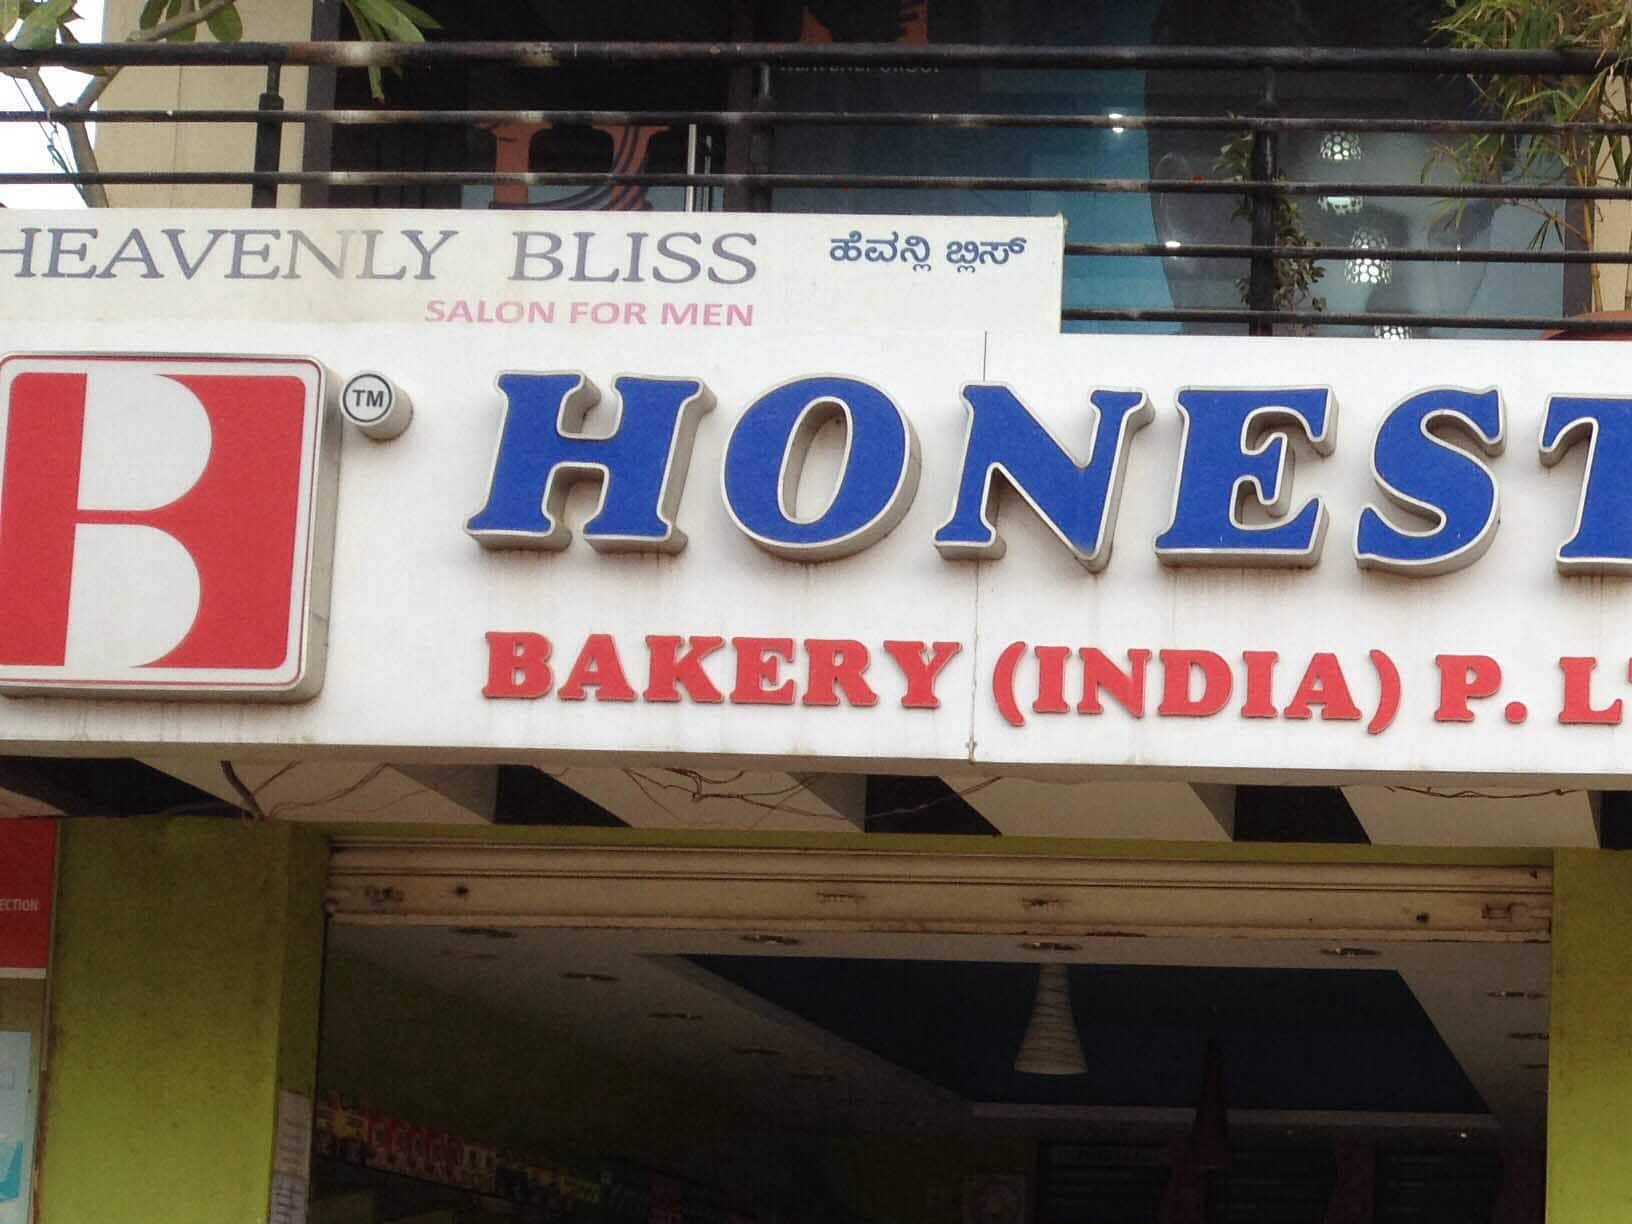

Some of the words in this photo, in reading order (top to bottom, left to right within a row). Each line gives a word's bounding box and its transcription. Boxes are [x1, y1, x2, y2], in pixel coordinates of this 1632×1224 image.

[512, 231, 759, 286] BLISS
[945, 236, 1028, 273] ಬ್ಲಿಸ್
[424, 299, 557, 325] SALON
[570, 300, 648, 326] FOR
[660, 301, 755, 328] MEN
[351, 388, 385, 408] TM
[483, 631, 963, 708] BAKERY
[992, 640, 1404, 735] (INDIA)
